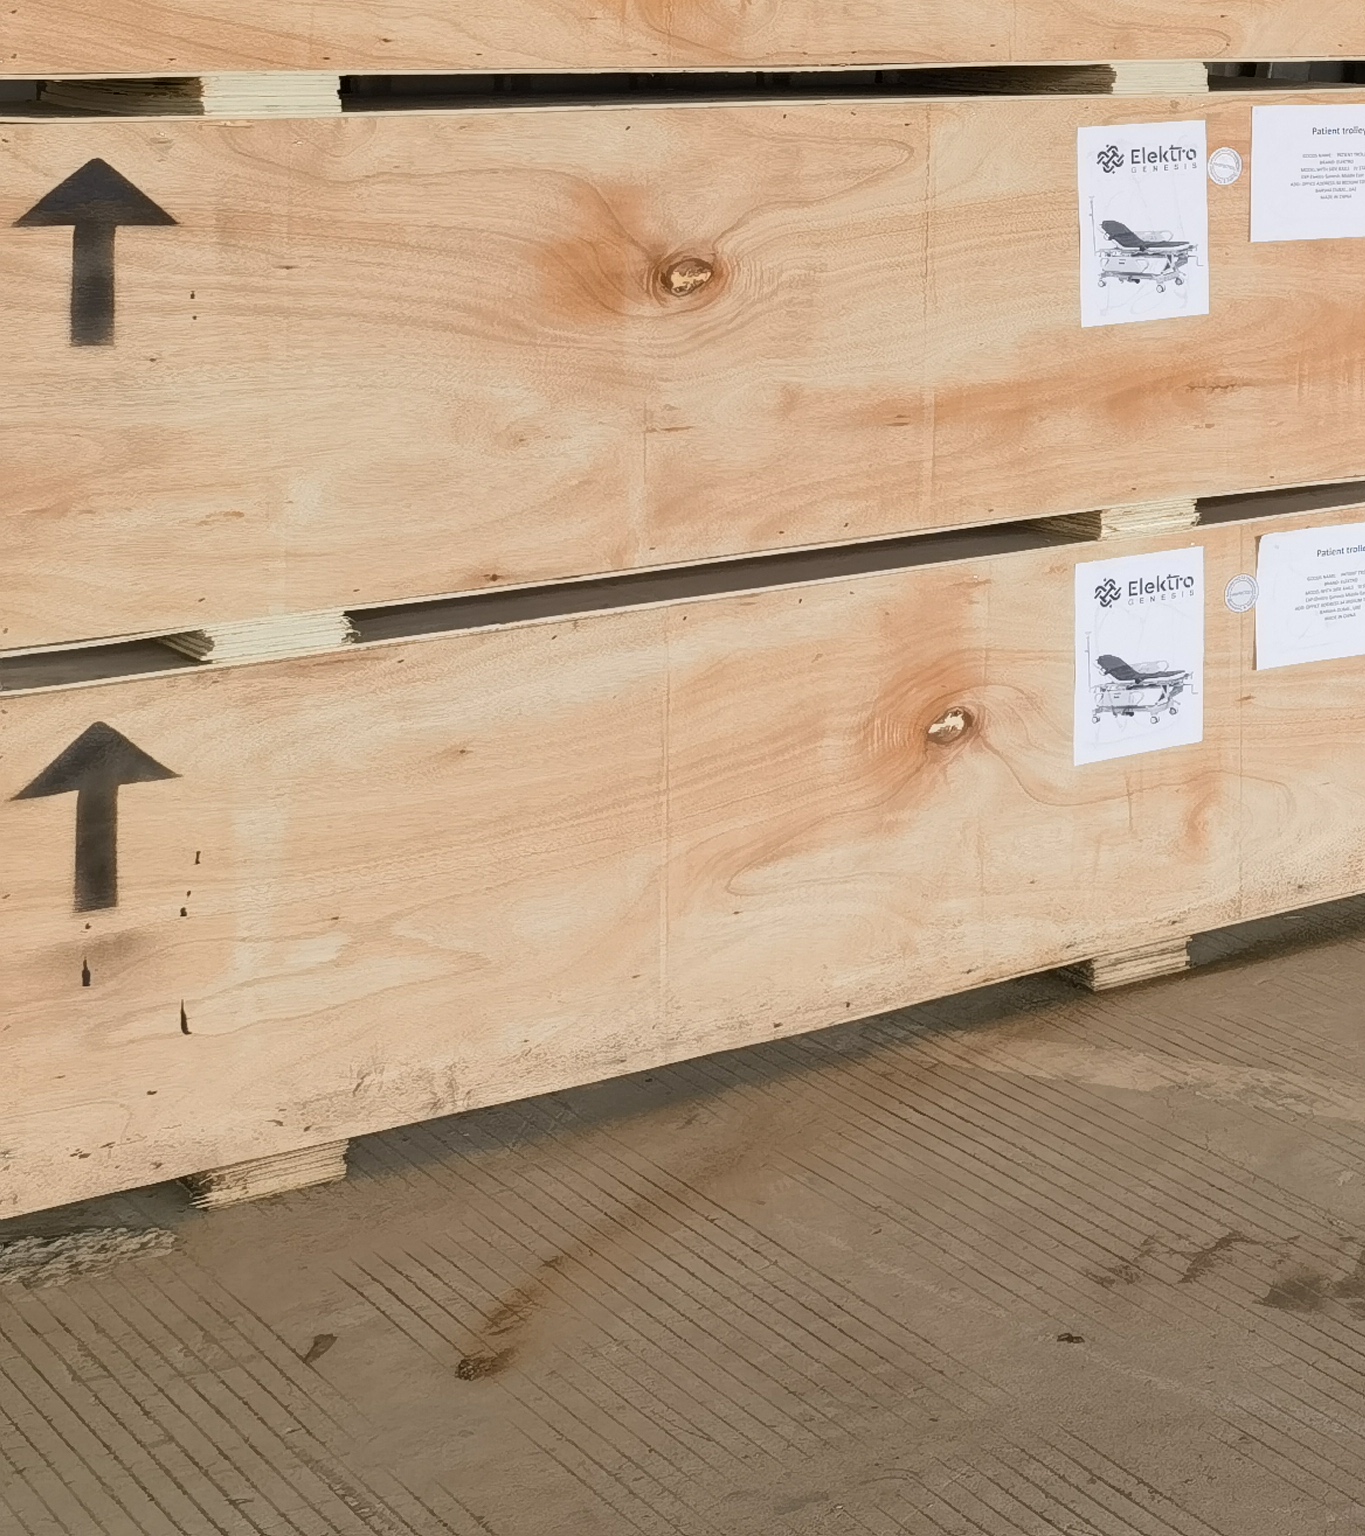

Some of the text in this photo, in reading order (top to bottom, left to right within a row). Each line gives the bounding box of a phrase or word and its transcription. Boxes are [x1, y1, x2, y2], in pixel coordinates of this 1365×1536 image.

[1312, 126, 1340, 136] Patient
[1131, 144, 1197, 165] Elektro
[1131, 163, 1197, 174] GENESIS
[1316, 547, 1344, 557] Patient
[1128, 574, 1194, 597] Elektro
[1127, 590, 1194, 606] GENESIS
